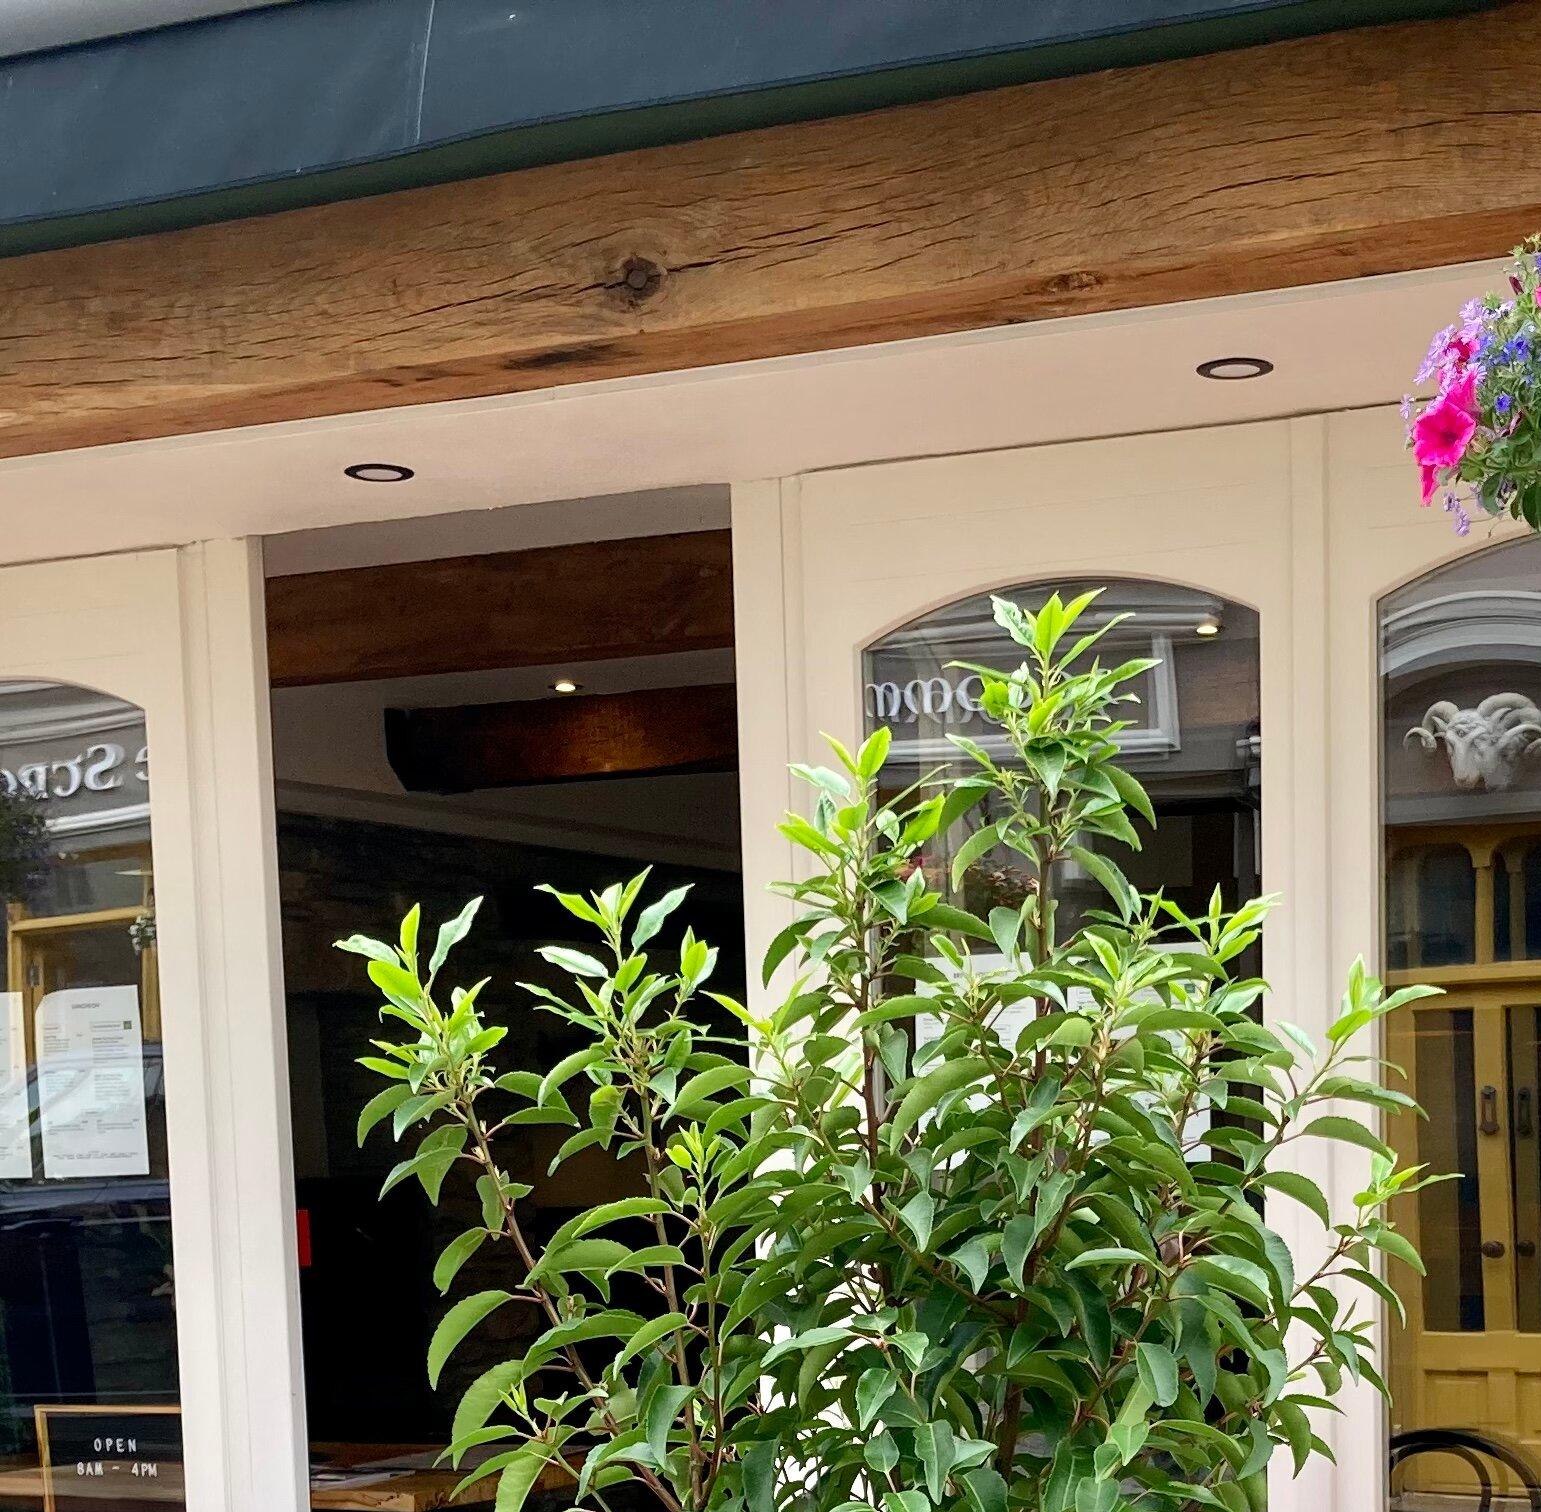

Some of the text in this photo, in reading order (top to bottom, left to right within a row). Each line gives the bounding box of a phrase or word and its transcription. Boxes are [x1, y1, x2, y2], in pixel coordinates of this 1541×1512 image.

[93, 1438, 137, 1452] OPEN
[76, 1461, 104, 1476] 8AM
[131, 1462, 158, 1477] 4PM
